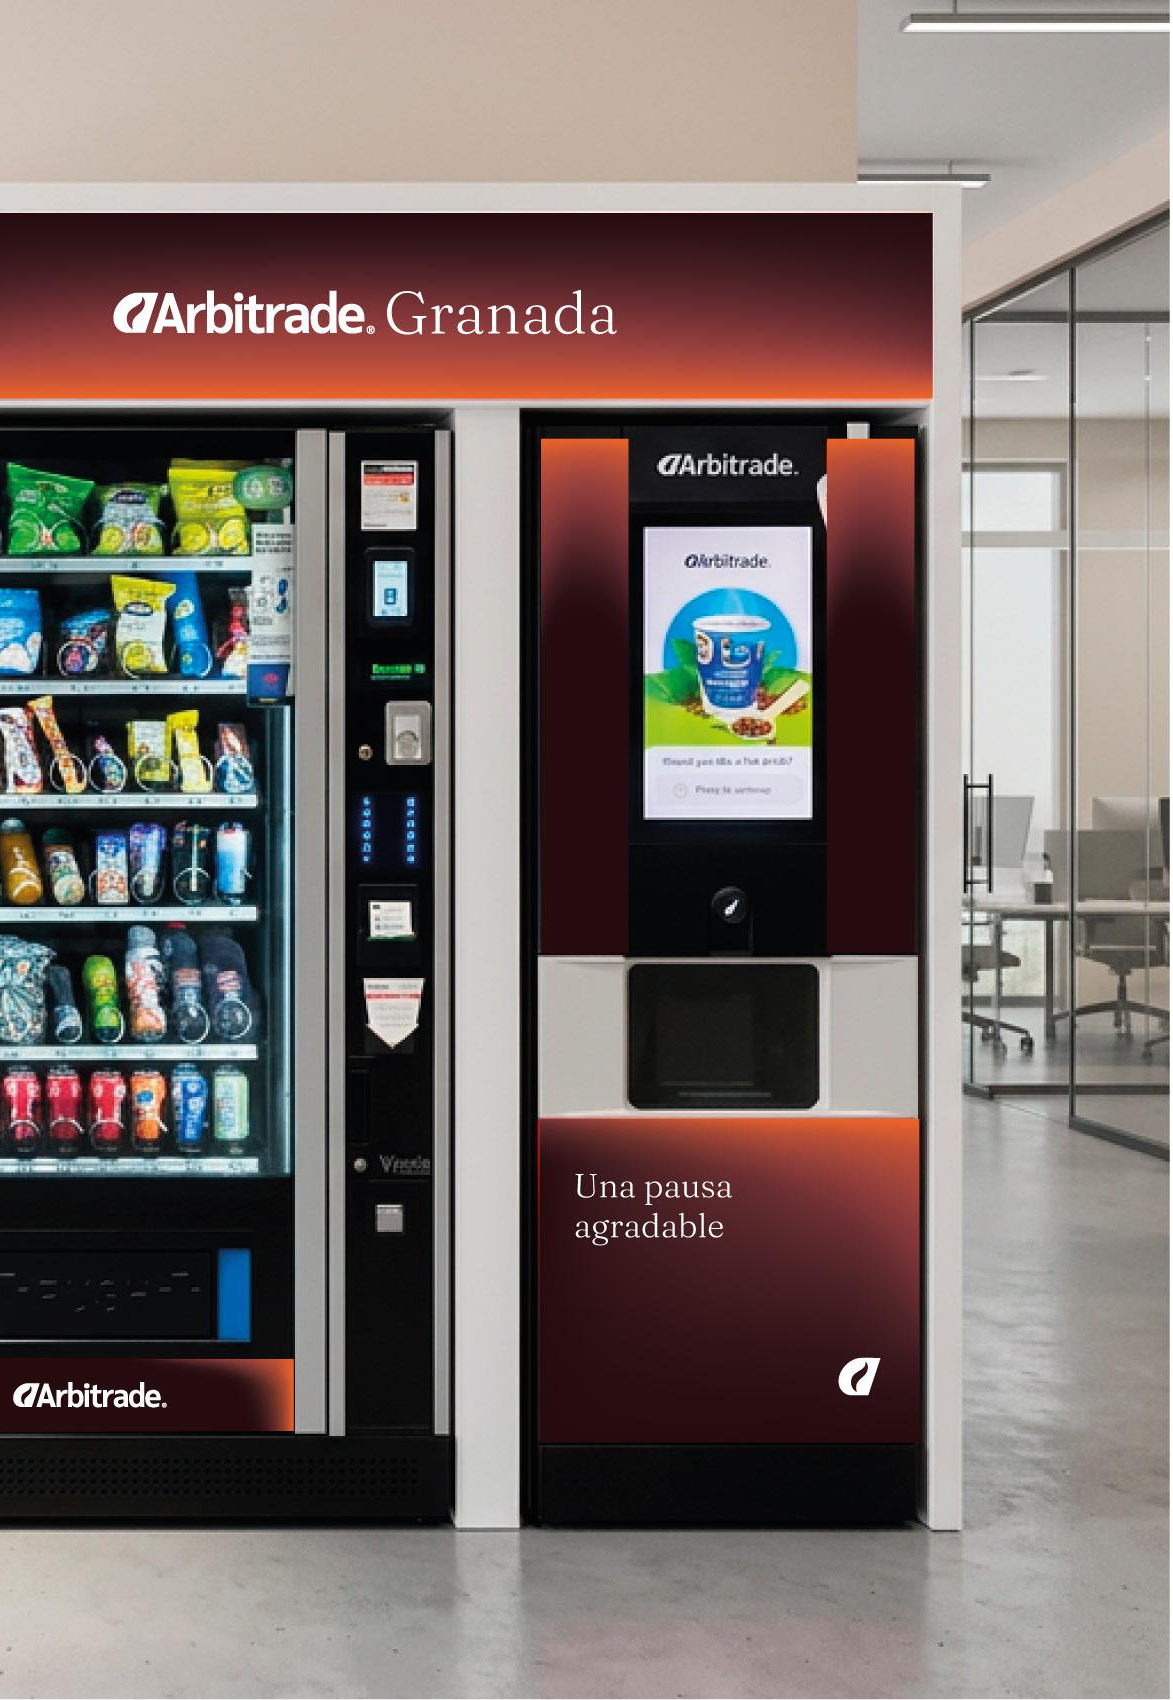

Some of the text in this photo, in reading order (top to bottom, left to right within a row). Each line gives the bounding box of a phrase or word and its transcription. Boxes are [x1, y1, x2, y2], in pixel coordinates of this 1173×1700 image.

[386, 289, 617, 336] Granada
[575, 1173, 733, 1206] Una pausa
[575, 1212, 724, 1246] agradable
